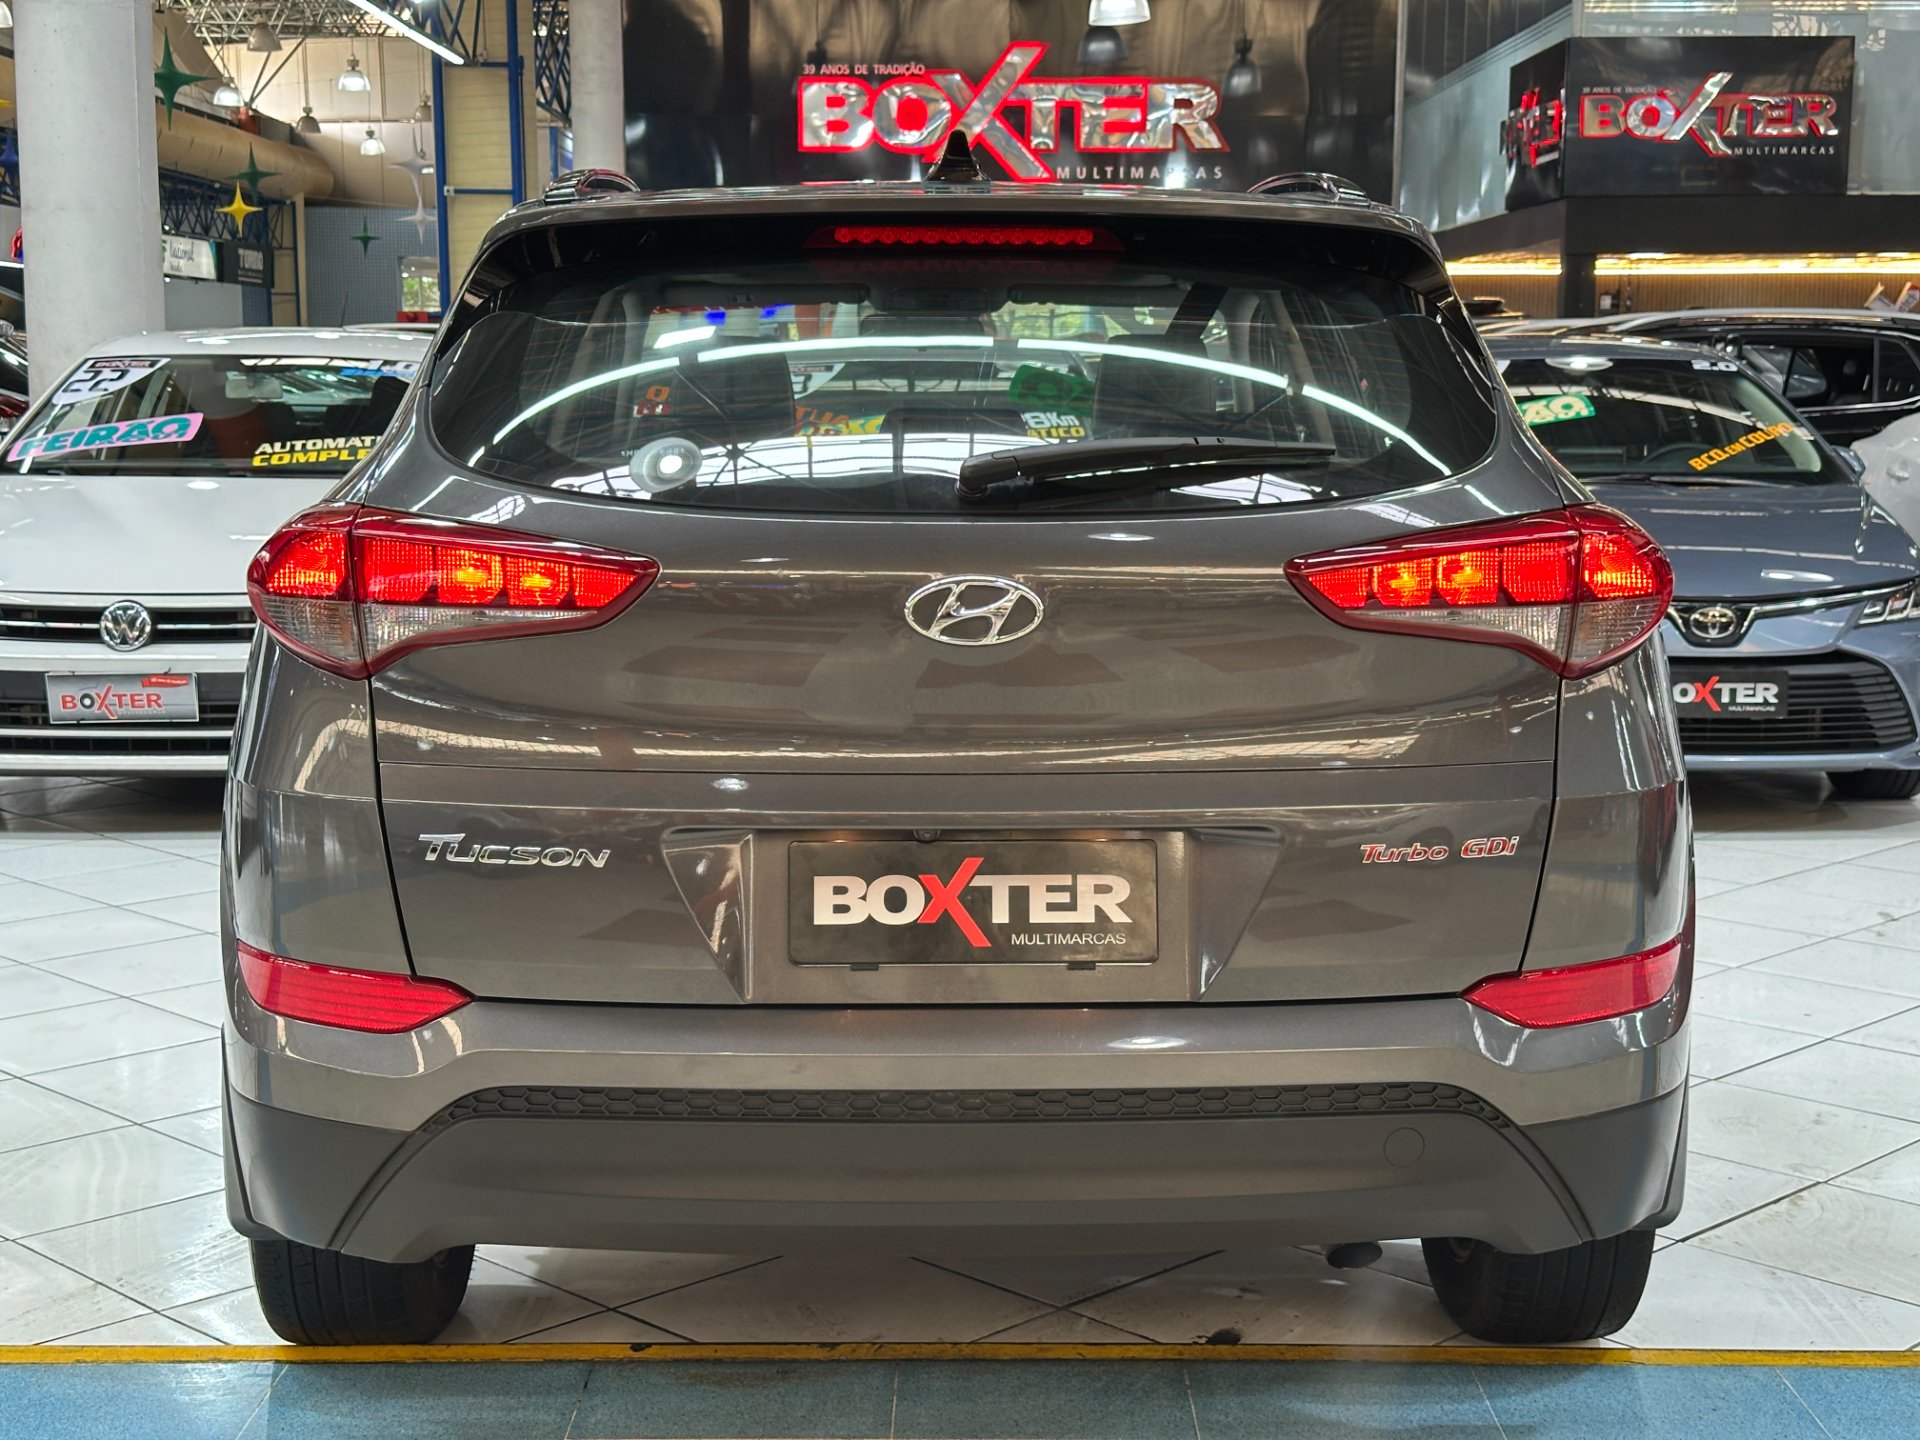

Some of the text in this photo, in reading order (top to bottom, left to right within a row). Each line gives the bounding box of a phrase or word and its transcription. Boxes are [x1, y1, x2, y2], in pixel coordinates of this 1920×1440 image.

[803, 61, 925, 76] 39 ANOS DE TRADIÇÃO
[798, 41, 1230, 182] BOXTER
[1578, 72, 1839, 157] BOXTER
[1733, 146, 1836, 155] MULTIMARCAS
[60, 684, 164, 719] BOXTER
[1672, 675, 1779, 712] OXTER
[1360, 836, 1519, 863] Turbo GDi
[813, 857, 1133, 947] BOXTER
[1011, 932, 1127, 945] MULTIMARCAS
